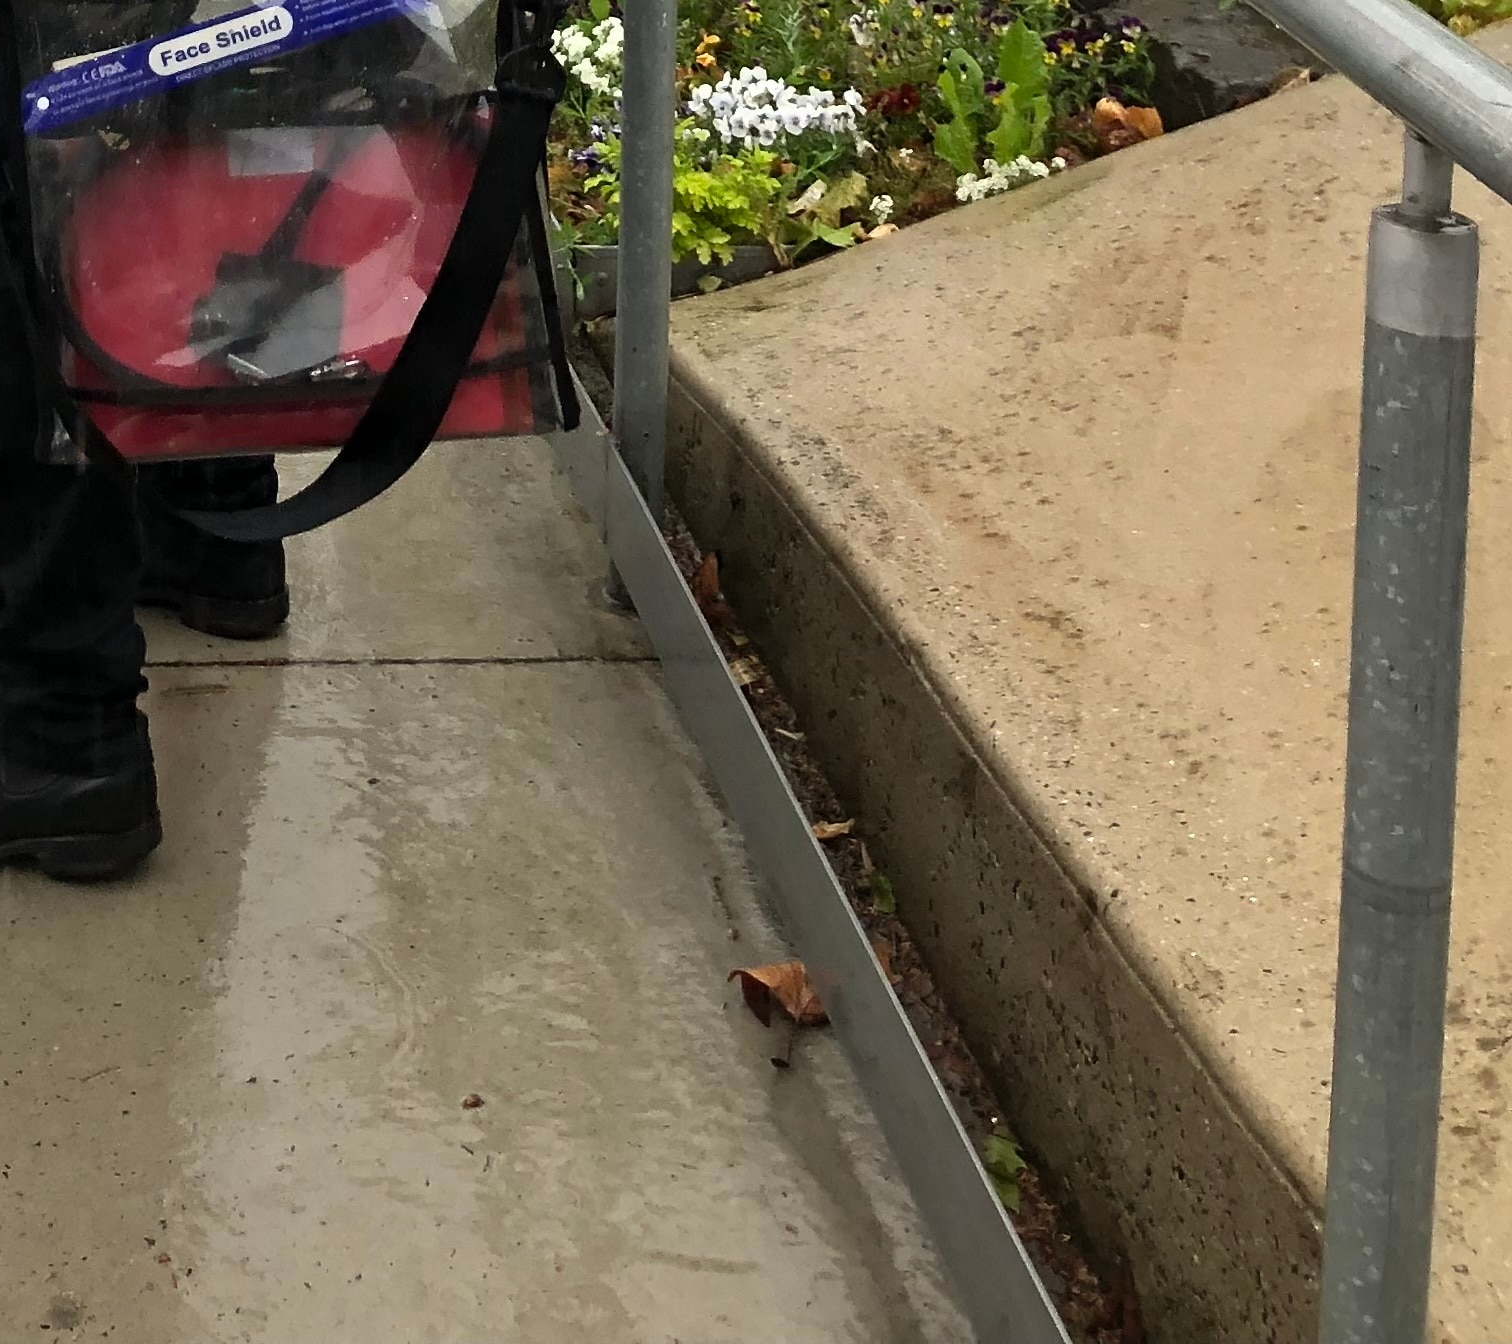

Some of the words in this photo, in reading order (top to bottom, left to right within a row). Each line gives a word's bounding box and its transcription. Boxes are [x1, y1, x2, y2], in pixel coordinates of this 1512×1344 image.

[160, 41, 211, 67] Face
[216, 15, 282, 48] Shield
[234, 44, 281, 64] PROTECTION
[98, 61, 127, 78] FDA
